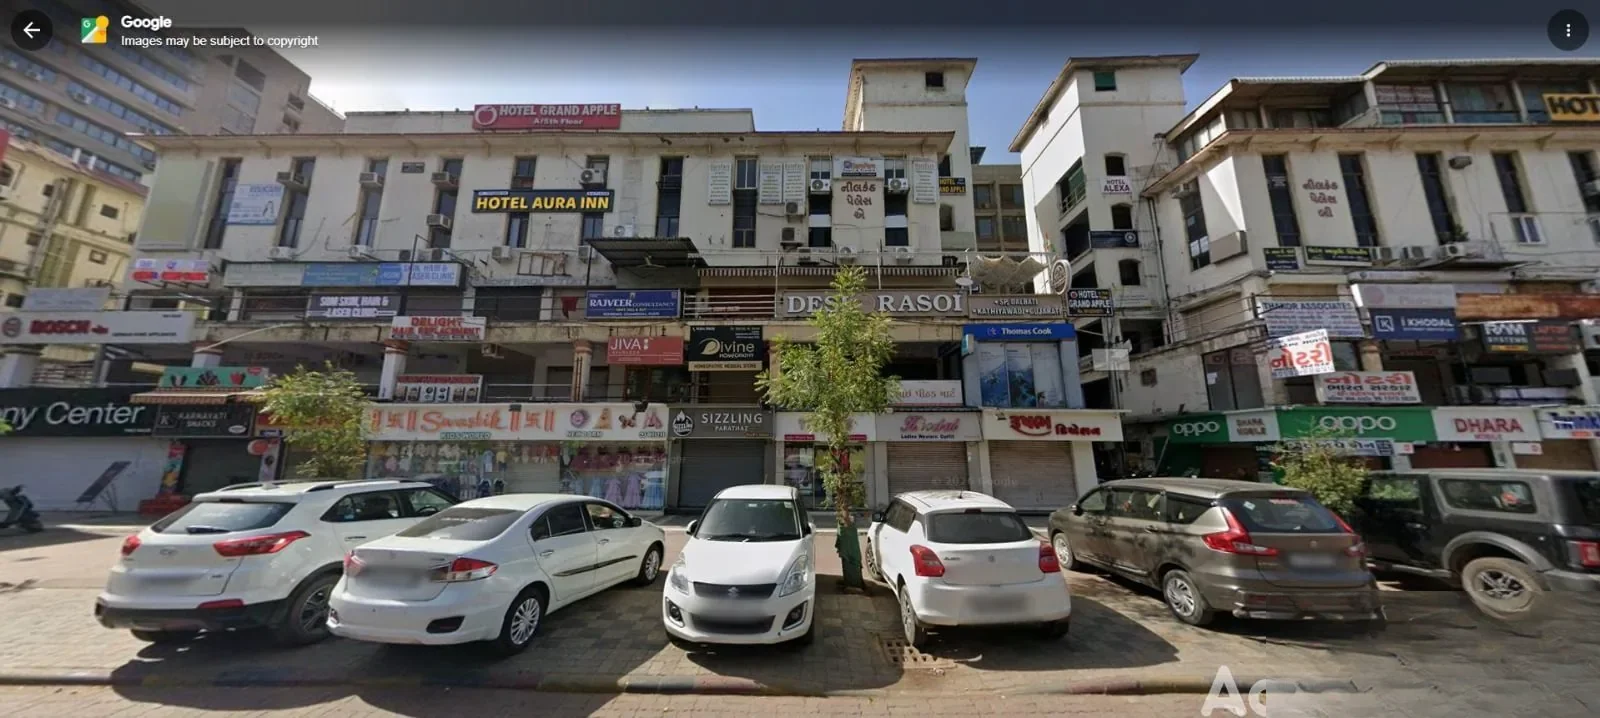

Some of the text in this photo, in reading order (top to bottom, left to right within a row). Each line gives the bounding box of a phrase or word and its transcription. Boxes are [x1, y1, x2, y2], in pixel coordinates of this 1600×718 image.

[500, 104, 617, 116] HOTEL GRAND APPLE
[476, 197, 609, 209] HOTEL AURA INN
[878, 294, 962, 312] RASOI
[30, 320, 90, 334] BOSCH
[412, 317, 464, 326] DELIGHT
[1484, 324, 1526, 335] RAM
[610, 338, 641, 350] JIVA
[45, 401, 146, 425] Center
[701, 413, 763, 424] SIZZLING
[1173, 421, 1220, 436] oppo
[1320, 415, 1396, 432] oppo
[1453, 418, 1524, 432] DHARA
